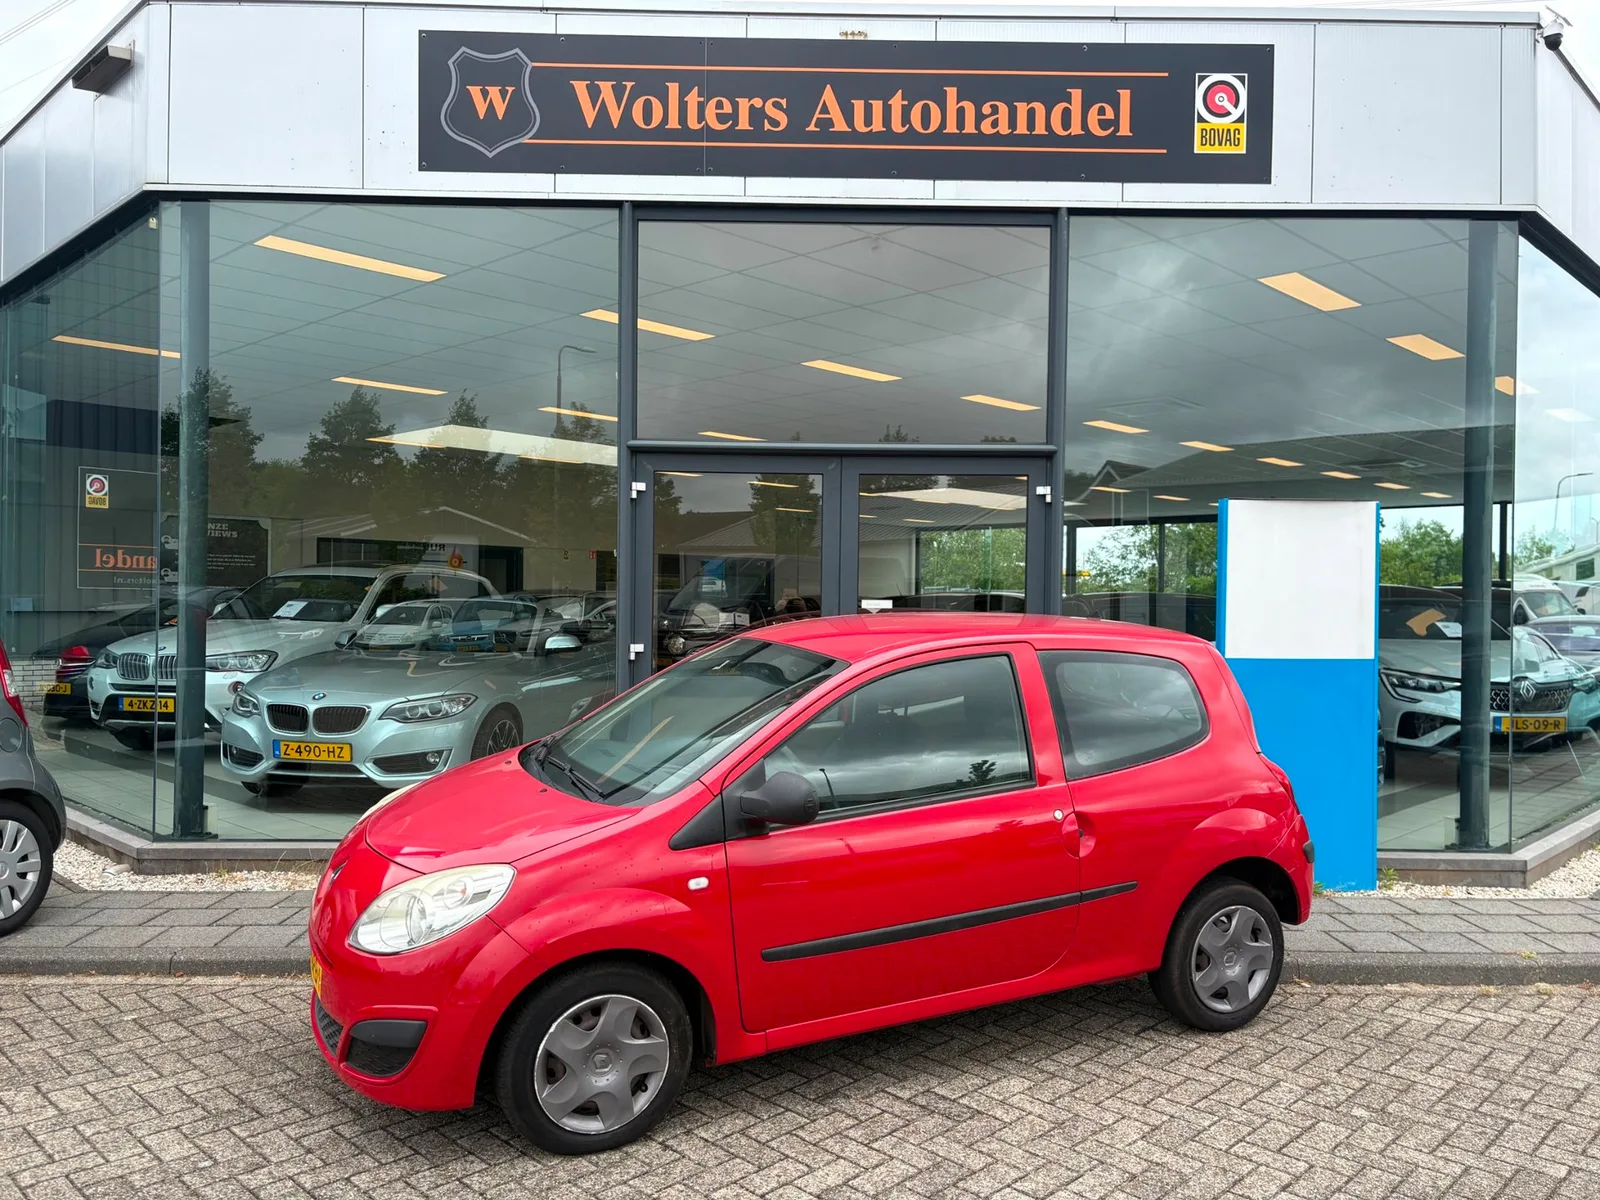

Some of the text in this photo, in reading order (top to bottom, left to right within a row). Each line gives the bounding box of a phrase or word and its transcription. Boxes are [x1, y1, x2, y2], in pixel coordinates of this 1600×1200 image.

[466, 85, 516, 120] W
[569, 80, 1133, 136] Wolters Autohandel
[1200, 127, 1241, 147] BOVAG
[127, 700, 169, 710] 4-ZKZ14
[283, 743, 345, 759] Z-490-HZ
